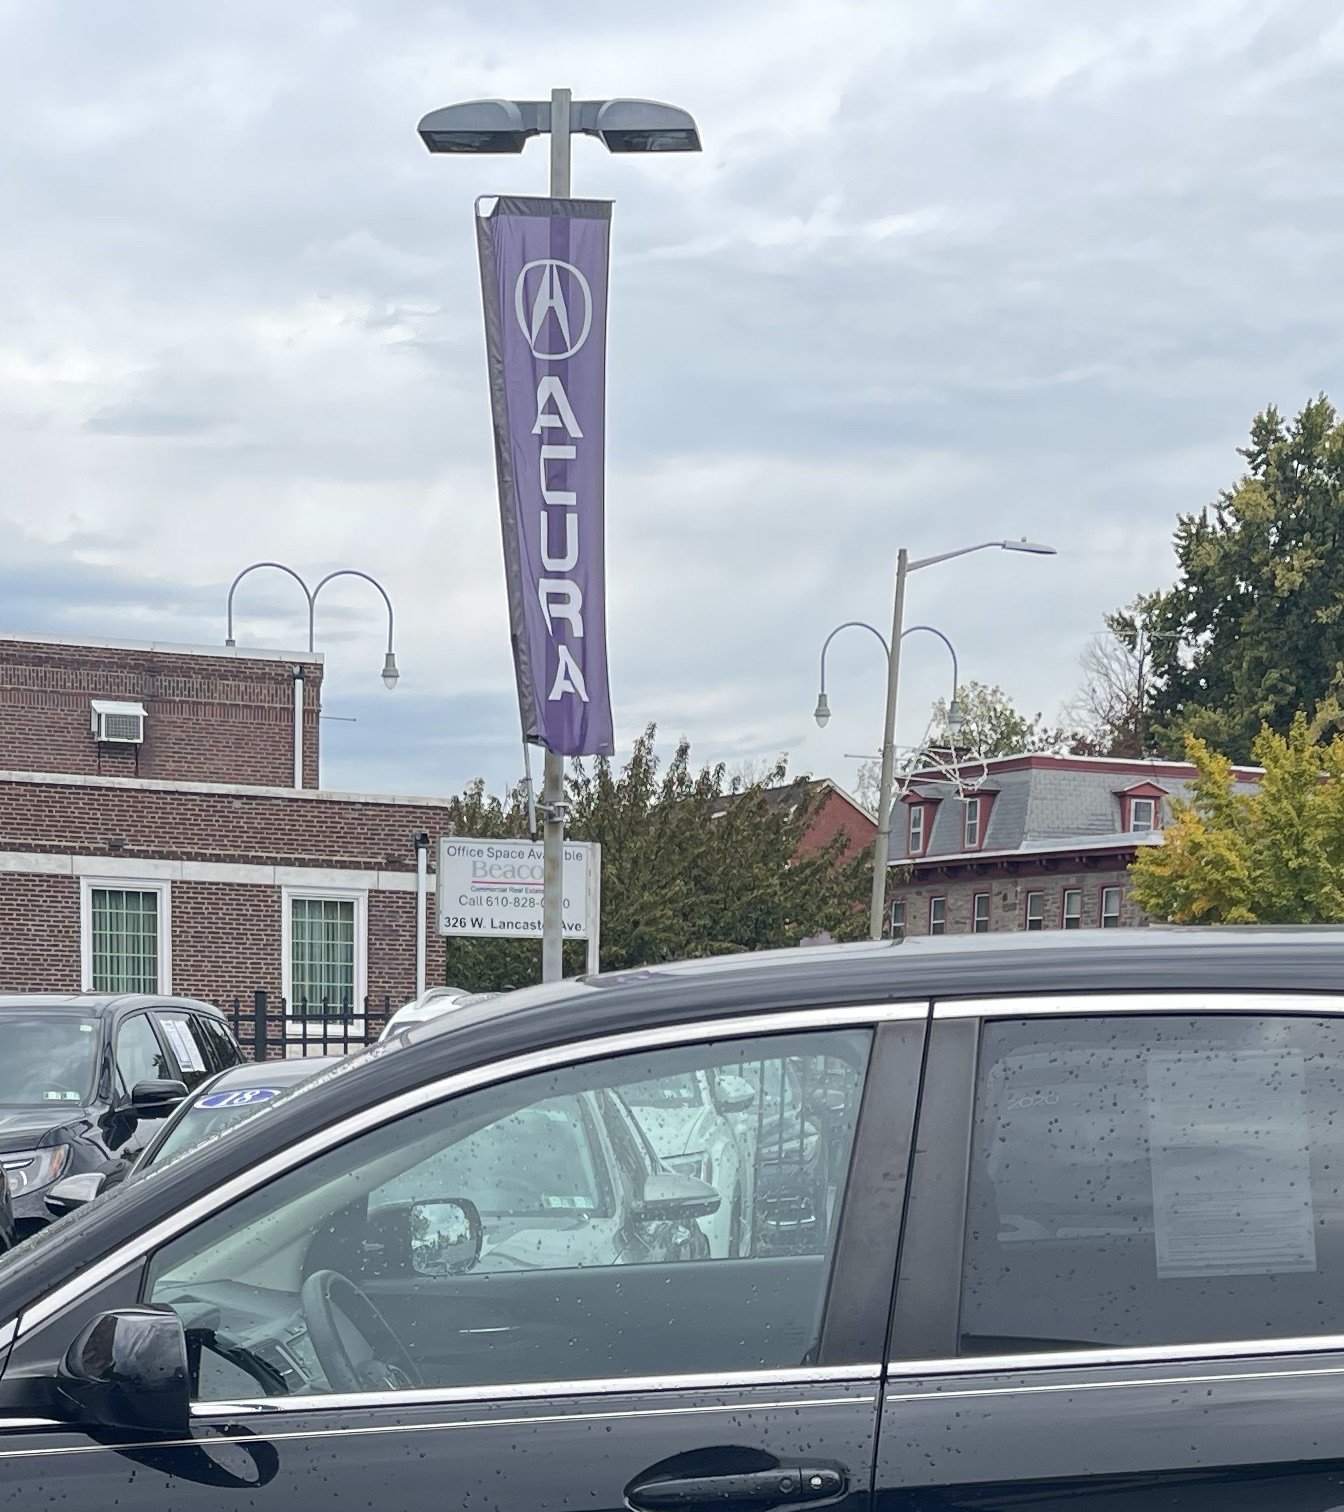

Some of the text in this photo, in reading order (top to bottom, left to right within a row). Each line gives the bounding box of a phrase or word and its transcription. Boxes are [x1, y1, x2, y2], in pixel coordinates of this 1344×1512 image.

[531, 376, 590, 702] ACURA
[446, 845, 583, 862] Office Space Avble
[471, 859, 545, 881] Beaco
[458, 894, 484, 907] Call
[443, 917, 586, 932] 326 W. Lancast Ave.
